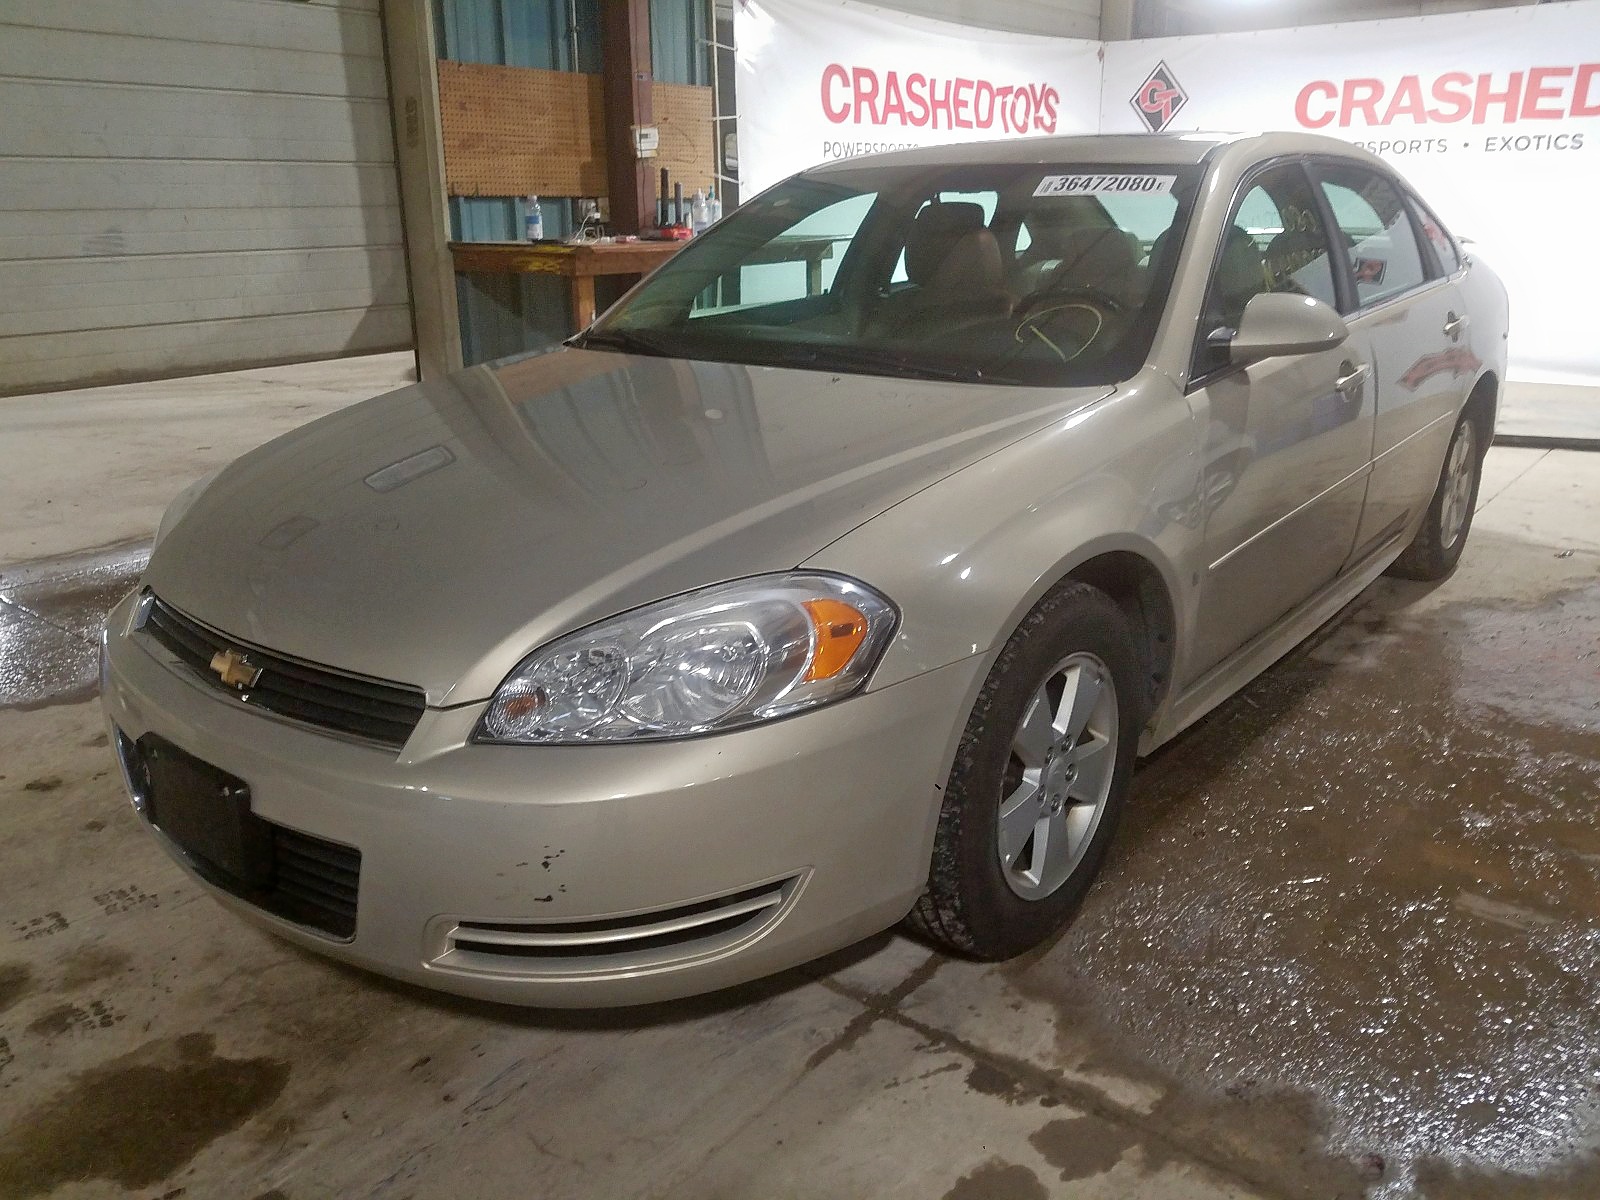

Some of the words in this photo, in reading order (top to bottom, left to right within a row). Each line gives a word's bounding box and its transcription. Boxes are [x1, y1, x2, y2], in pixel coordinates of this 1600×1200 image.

[821, 63, 1060, 134] CRASHEDTOYS
[1484, 133, 1584, 152] EXOTICS
[1053, 176, 1158, 192] 36472080
